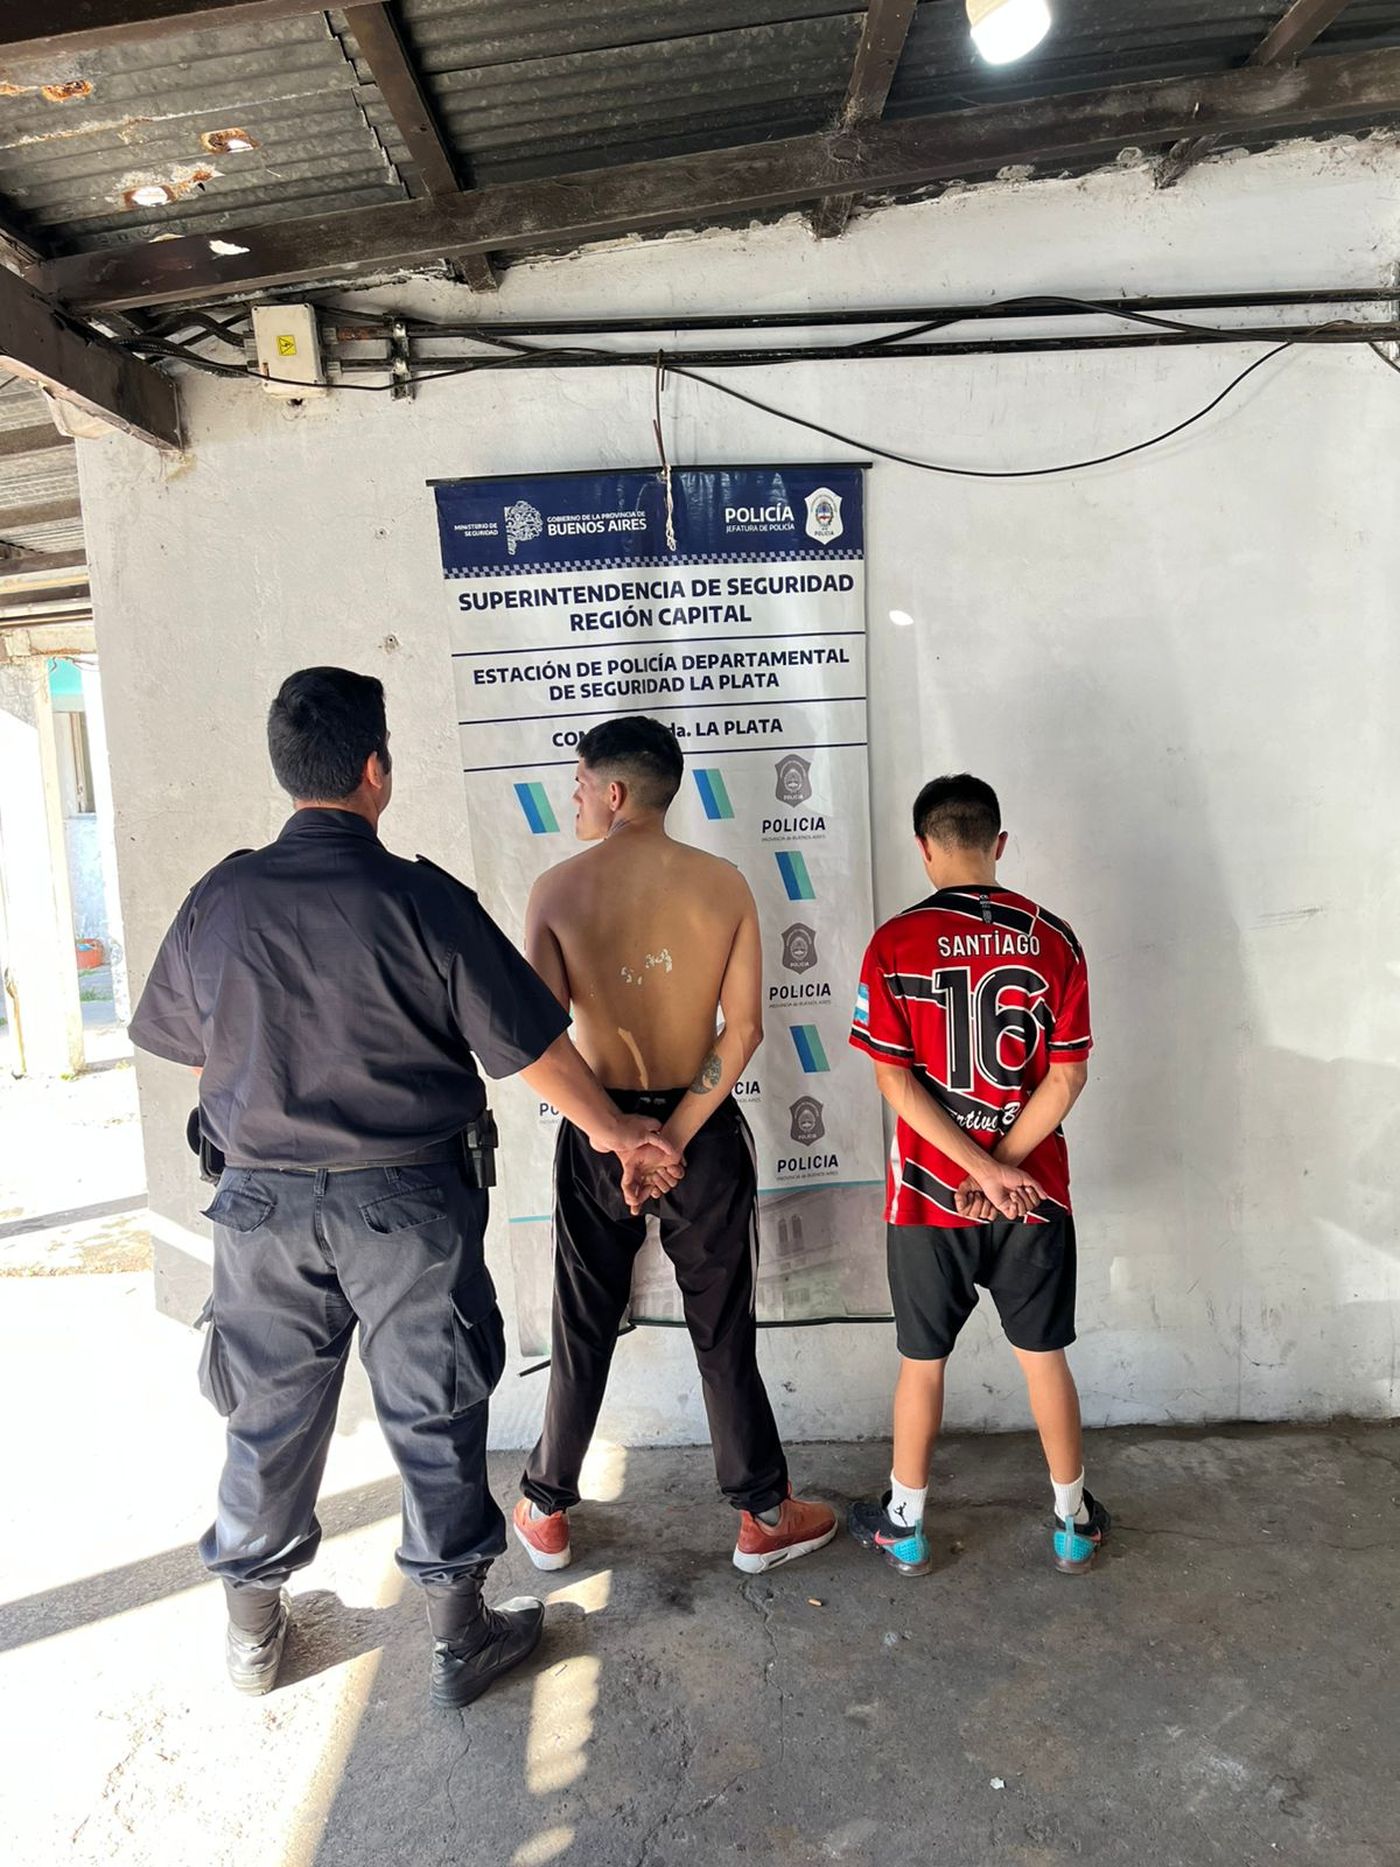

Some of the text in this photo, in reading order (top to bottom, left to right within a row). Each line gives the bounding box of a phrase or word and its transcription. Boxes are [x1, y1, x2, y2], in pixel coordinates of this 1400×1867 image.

[725, 503, 794, 523] POLICÍA
[548, 518, 647, 536] BUENOS AIRES
[726, 522, 795, 533] JEFATURA DE POLICÍA
[458, 574, 854, 611] SUPERINTENDENCIA DE SEGURIDAD
[570, 604, 752, 631] REGIÓN CAPITAL
[473, 649, 850, 685] ESTACIÓN DE POLICÍA DEPARTAMENTAL
[550, 672, 780, 700] DE SEGURIDAD LA PLATA
[696, 721, 720, 736] LA
[724, 718, 783, 735] PLATA
[762, 817, 825, 833] POLICIA
[769, 983, 831, 1001] POLICIA
[931, 965, 1049, 1093] 16
[777, 1154, 839, 1173] POLICIA
